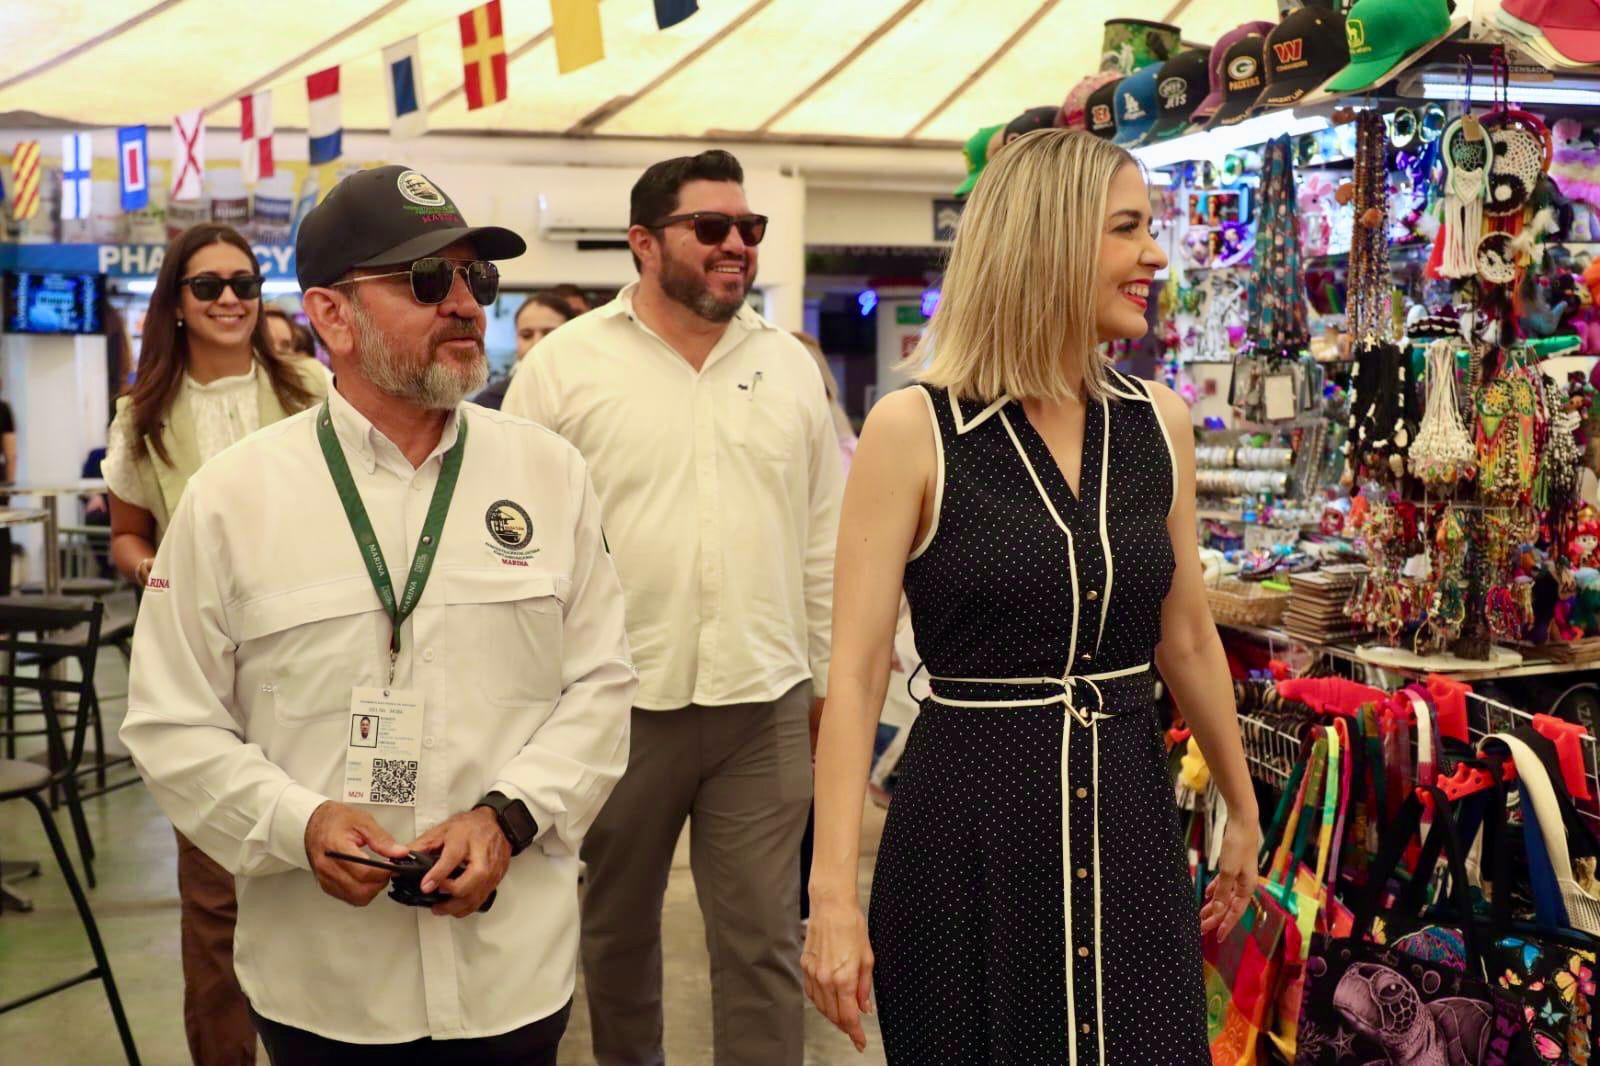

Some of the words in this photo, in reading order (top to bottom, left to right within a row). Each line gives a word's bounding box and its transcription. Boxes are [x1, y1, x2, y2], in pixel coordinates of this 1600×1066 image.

[1273, 38, 1303, 64] W
[1228, 76, 1261, 91] PACKERS
[98, 245, 294, 275] PHACY
[368, 543, 386, 578] MARINA
[501, 558, 529, 567] MARINA
[401, 580, 418, 614] MARINA
